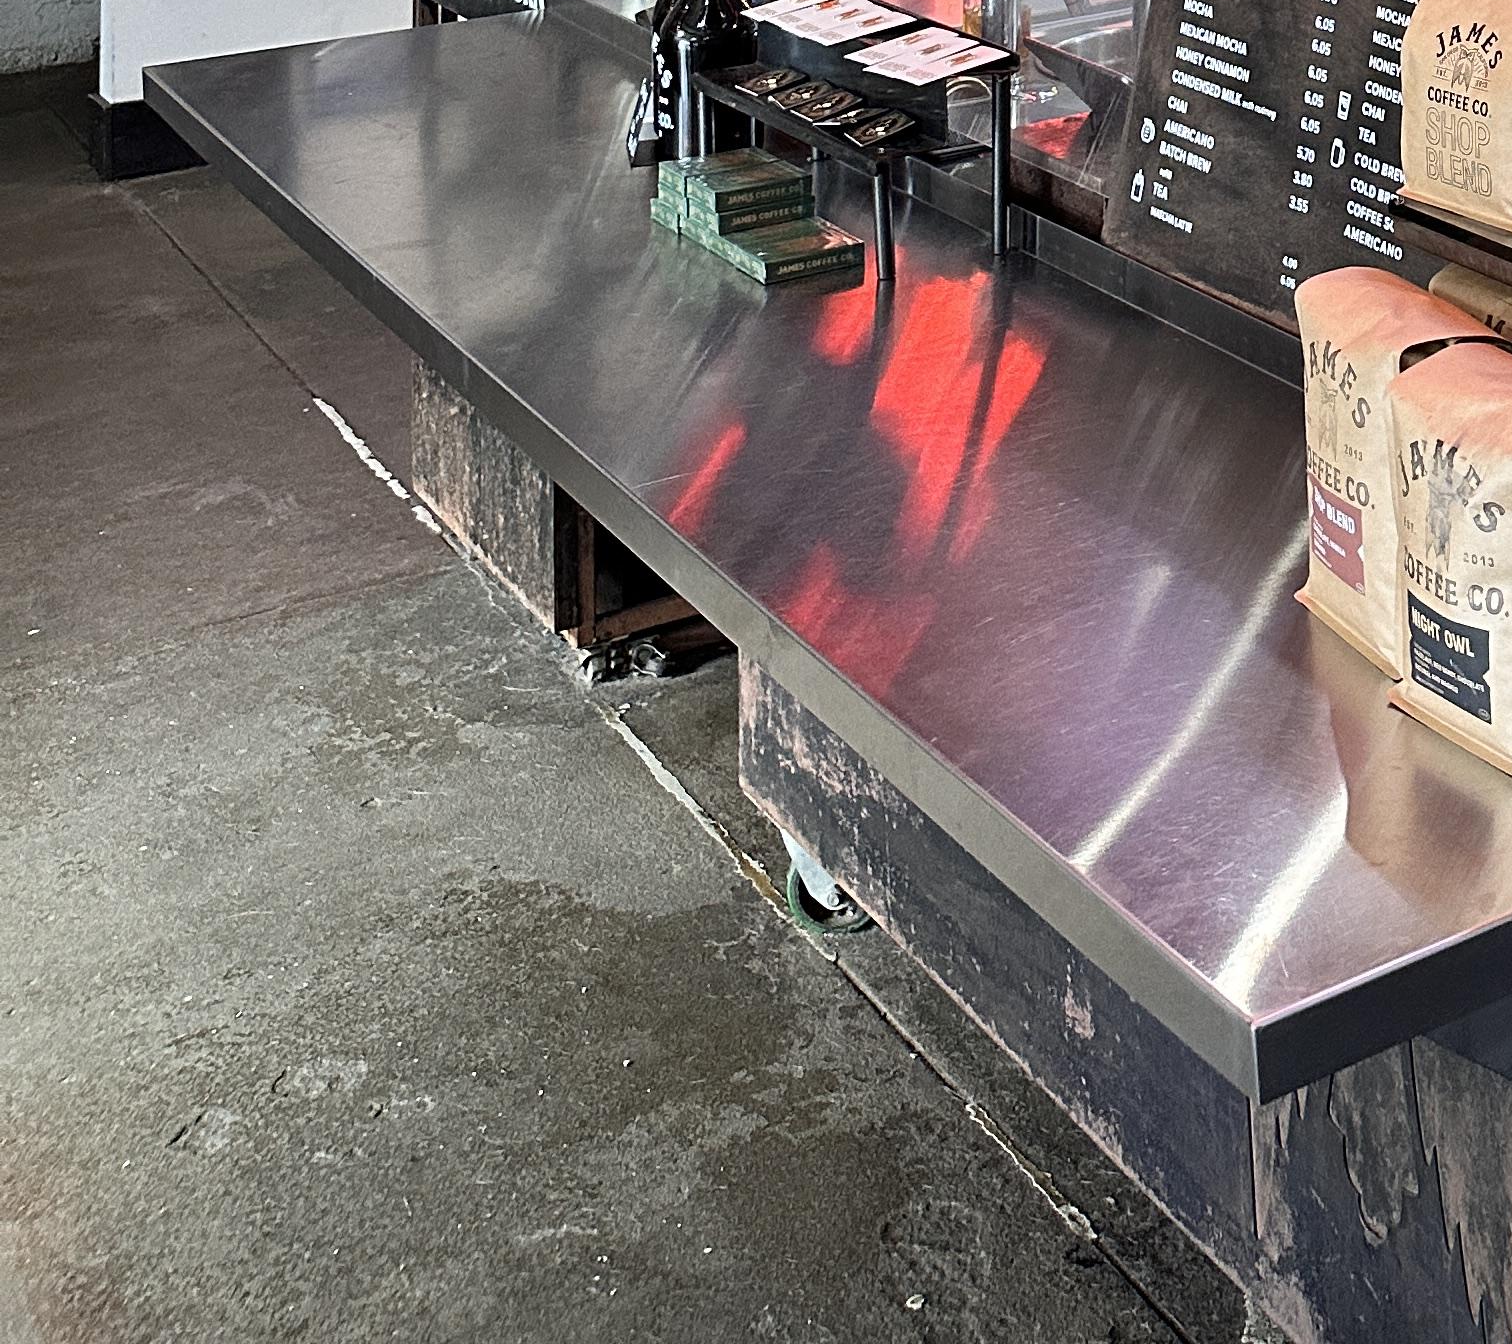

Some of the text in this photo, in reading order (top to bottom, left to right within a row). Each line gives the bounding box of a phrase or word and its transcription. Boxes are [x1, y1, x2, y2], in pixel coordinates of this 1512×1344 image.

[1315, 15, 1336, 33] 6.05
[1376, 5, 1411, 28] MOCHA
[1179, 21, 1332, 56] MEXICAN MOCHA 6.05
[1436, 22, 1503, 69] JAMES
[1175, 46, 1329, 83] HONEY CINNAMON 6.05
[1172, 69, 1325, 108] CONDENSED MILK 6.05
[1427, 86, 1492, 119] COFFEE CO.
[1167, 95, 1321, 135] CHAI 6.05
[1361, 101, 1386, 122] CHAI
[1163, 118, 1316, 164] AMERICANO 5.70
[1358, 126, 1377, 146] TEA
[1425, 106, 1491, 159] SHOP
[1159, 140, 1314, 188] BATCH BREW 3.80
[1354, 152, 1381, 174] COLD
[1426, 146, 1493, 198] BLEND
[1152, 181, 1309, 214] TEA 3.55
[1350, 177, 1376, 199] COLD
[1346, 200, 1382, 227] COFFEE
[1343, 223, 1403, 261] AMERICANO
[1307, 444, 1375, 510] OFFEE CO.
[1326, 505, 1356, 535] BLEND
[1463, 552, 1495, 568] 2013
[1467, 584, 1510, 618] CO.
[1411, 605, 1475, 658] NIGHT OWL
